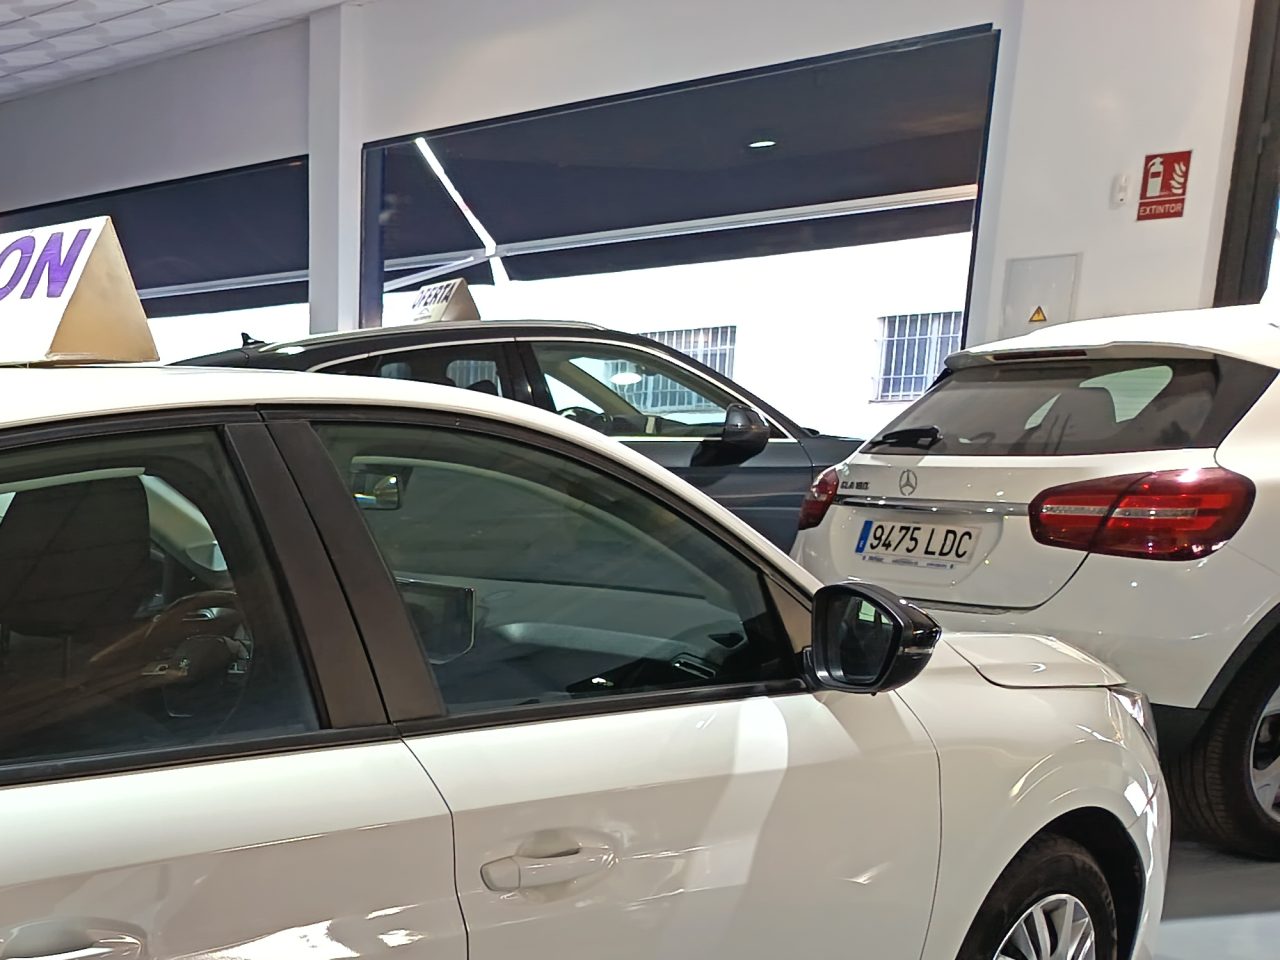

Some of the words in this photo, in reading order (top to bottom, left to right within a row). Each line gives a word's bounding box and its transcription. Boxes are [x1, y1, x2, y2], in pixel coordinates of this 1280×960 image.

[1139, 203, 1183, 216] EXTINTOR
[870, 524, 921, 553] 9475
[924, 528, 972, 558] LDC
